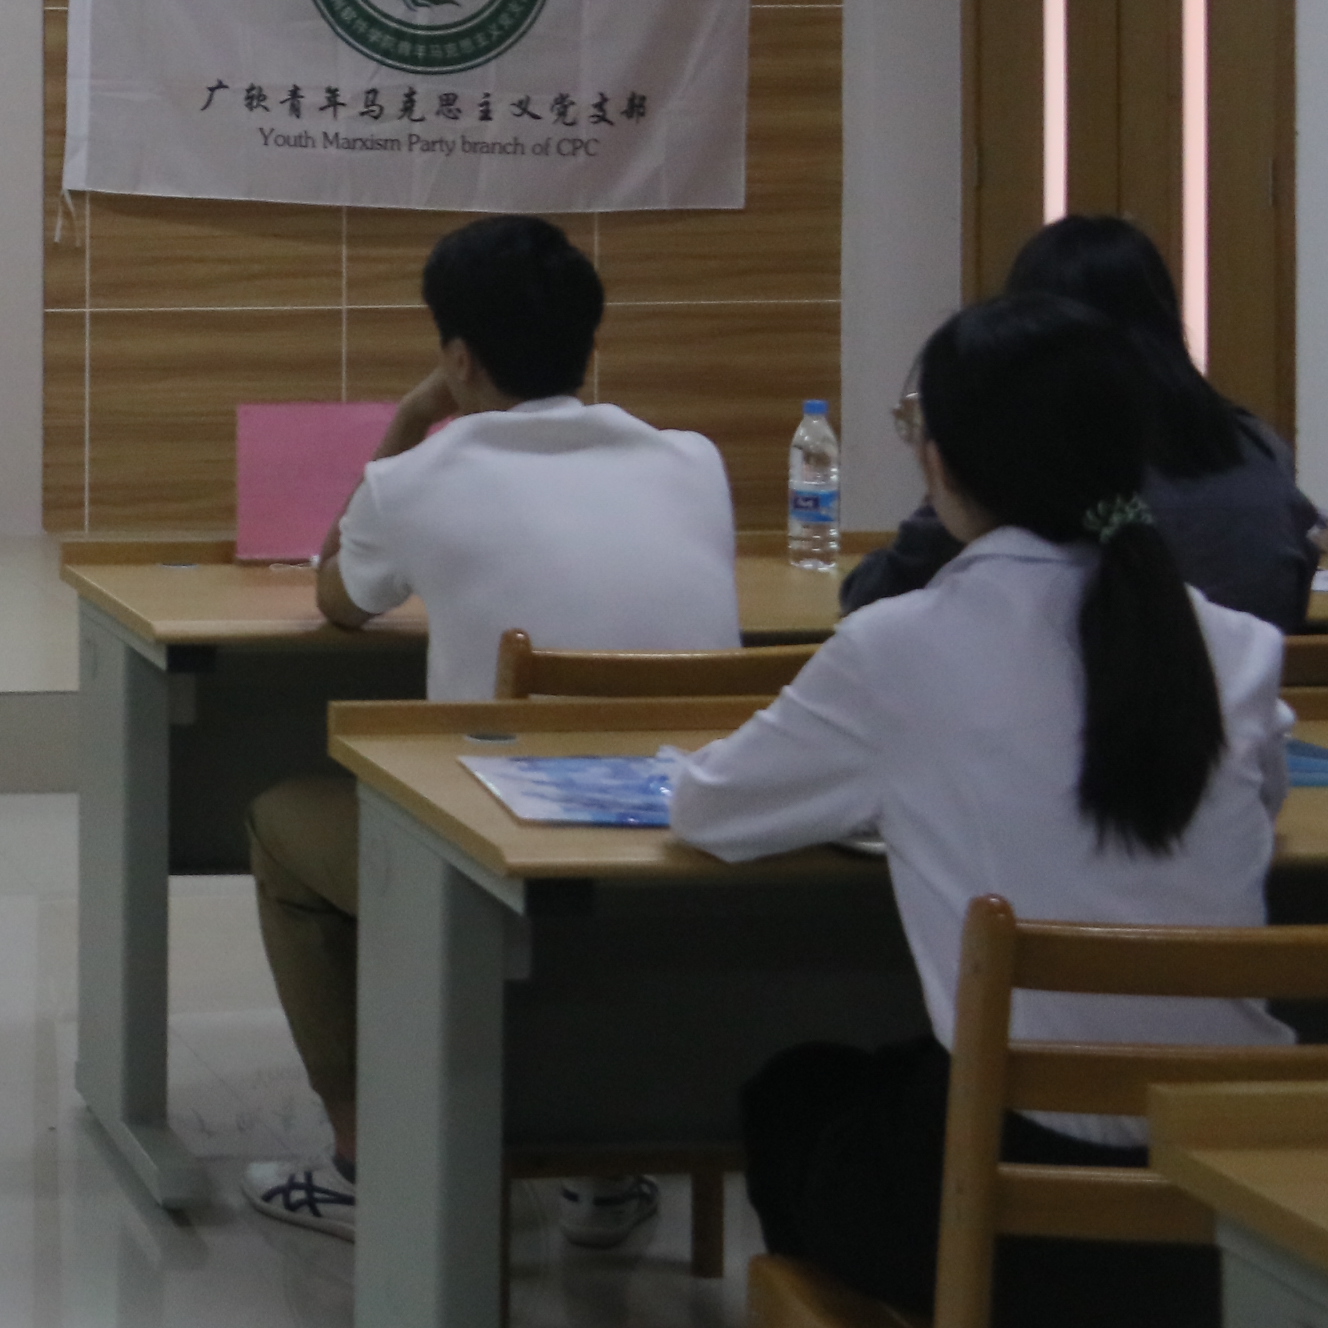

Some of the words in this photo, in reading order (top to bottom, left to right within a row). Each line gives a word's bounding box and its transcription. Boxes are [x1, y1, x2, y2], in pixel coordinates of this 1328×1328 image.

[199, 78, 648, 127] 广软青年马克思主义党支部
[258, 127, 316, 149] Youth
[322, 131, 402, 153] Marxism
[407, 133, 457, 157] Party
[460, 134, 527, 157] branch
[531, 136, 554, 157] of
[555, 137, 600, 157] CPC
